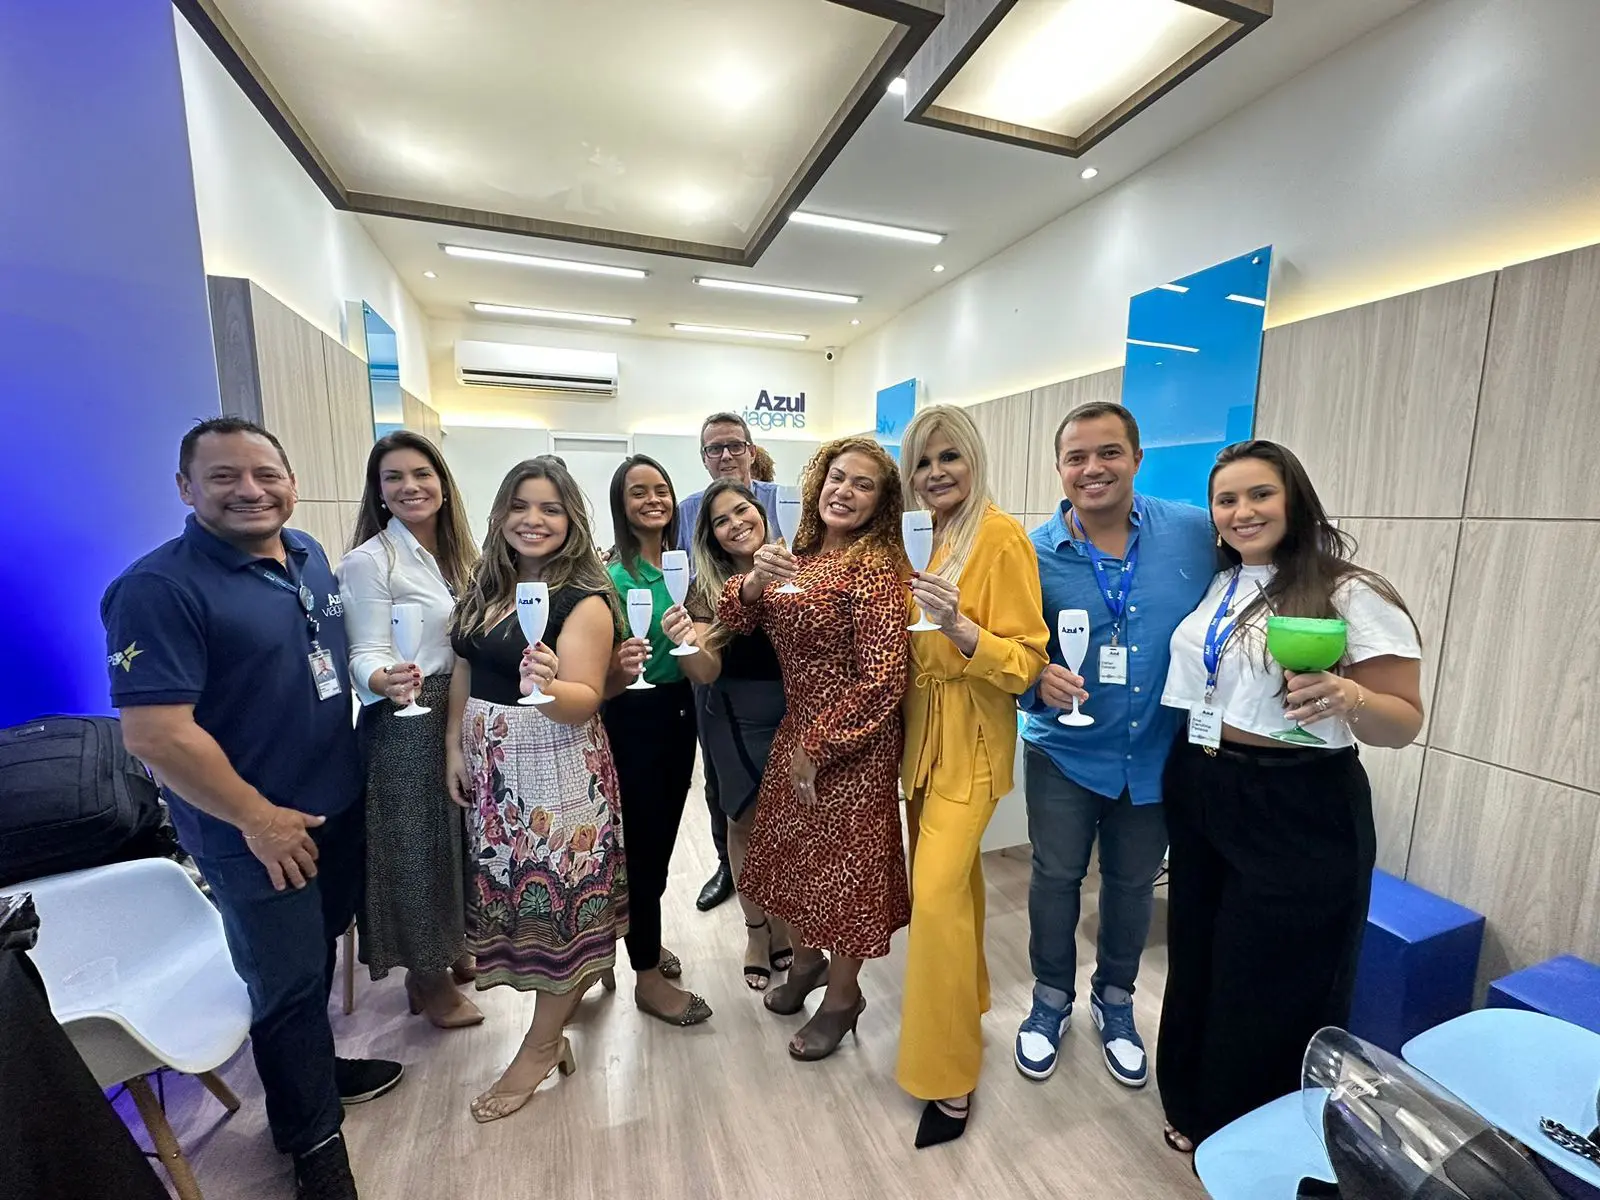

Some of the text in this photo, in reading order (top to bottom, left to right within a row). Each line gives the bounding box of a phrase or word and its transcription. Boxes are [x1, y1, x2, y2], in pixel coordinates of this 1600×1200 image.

[754, 389, 805, 413] Azul
[518, 597, 534, 605] Azul
[1061, 626, 1077, 634] Azul
